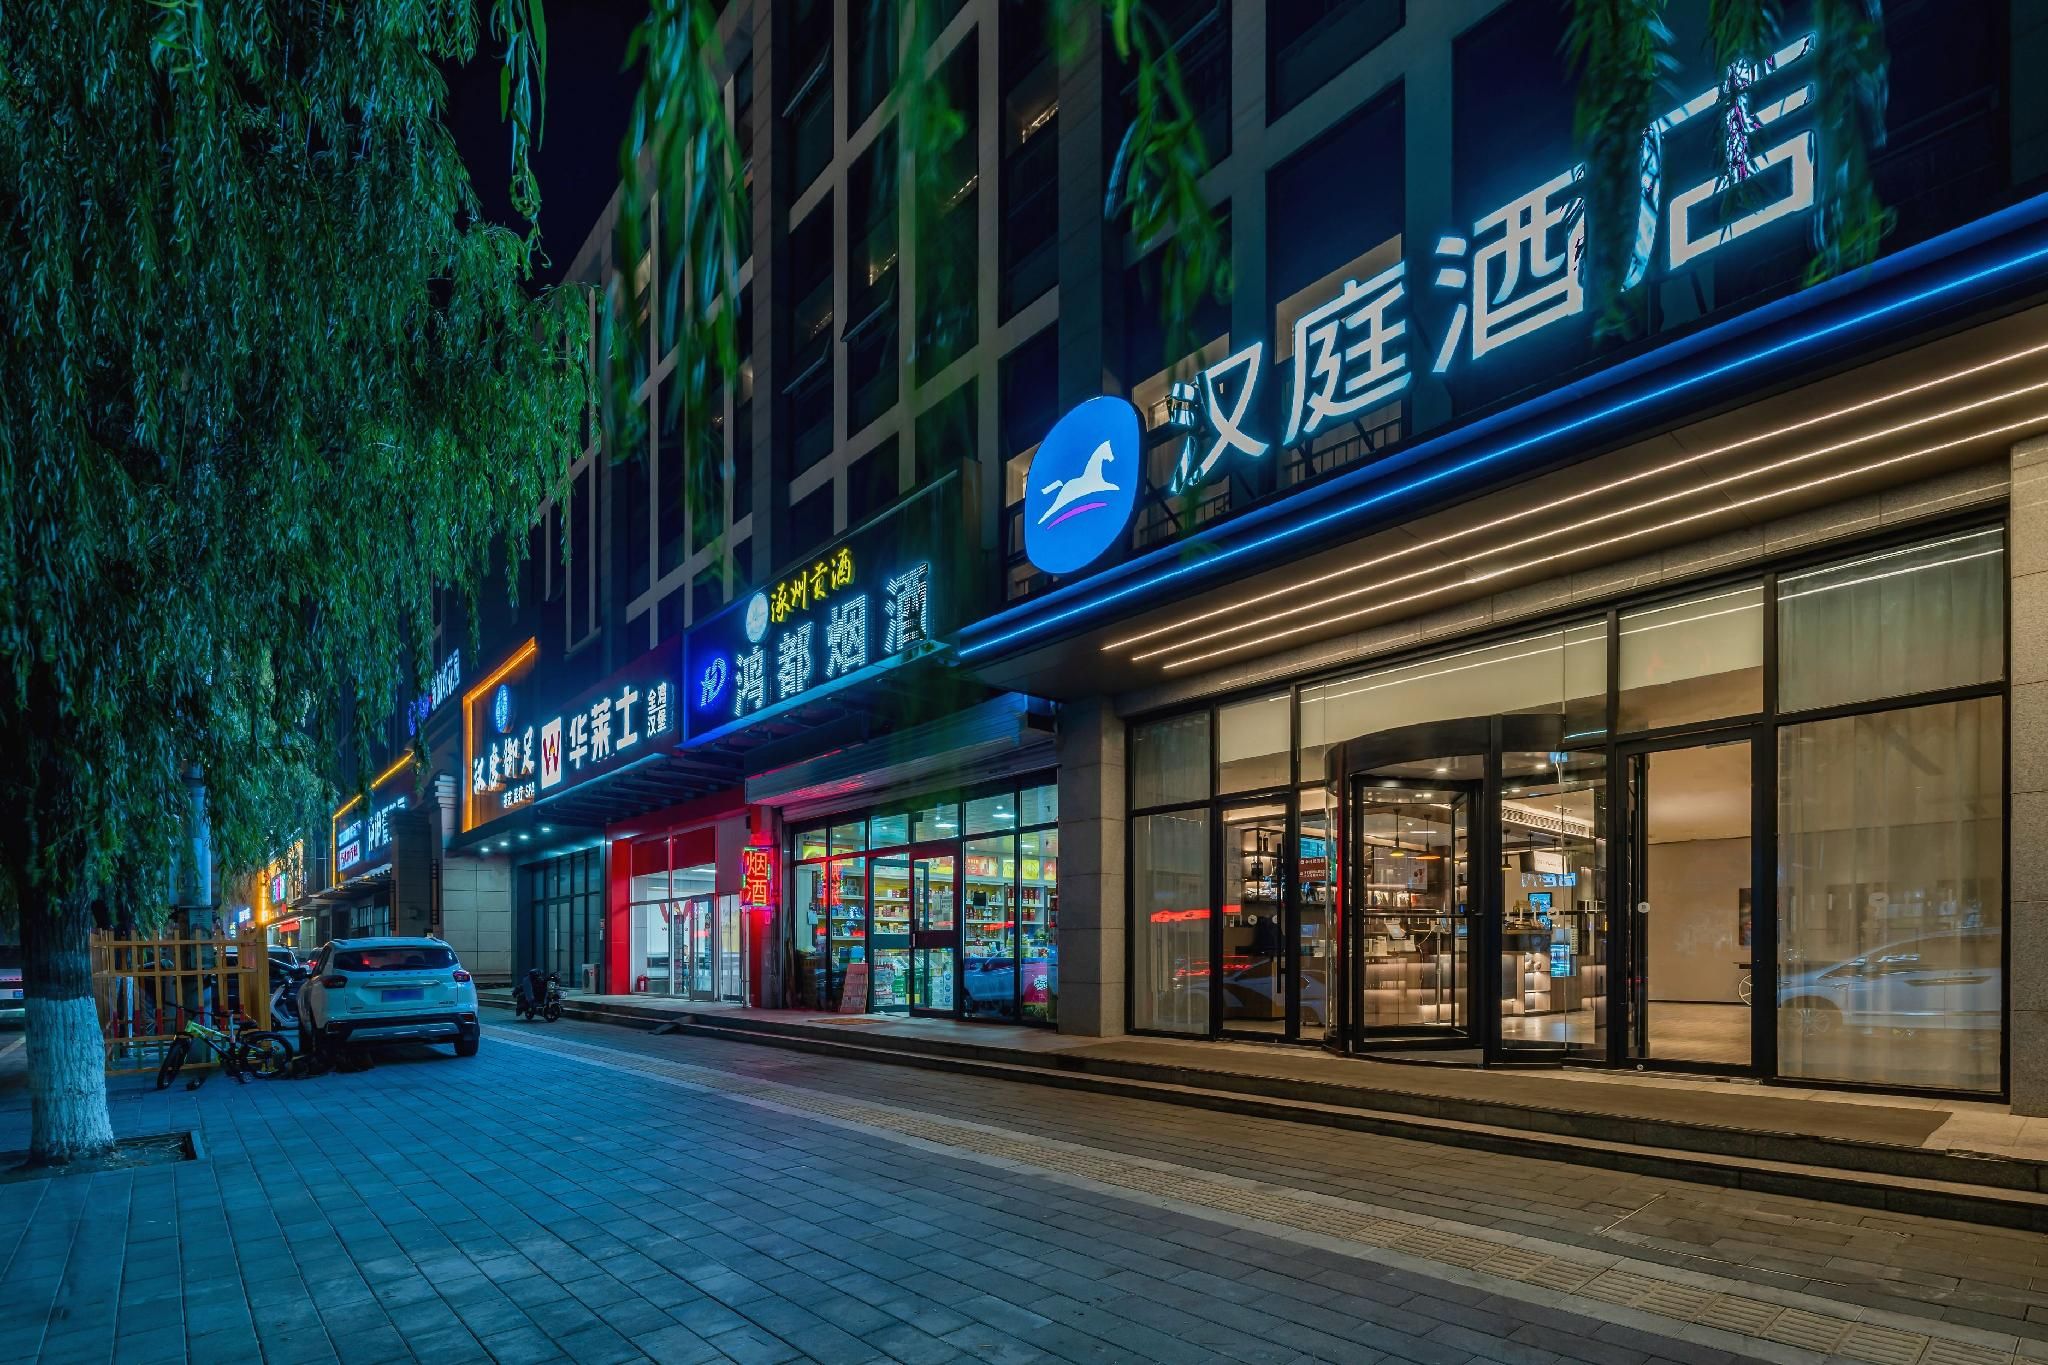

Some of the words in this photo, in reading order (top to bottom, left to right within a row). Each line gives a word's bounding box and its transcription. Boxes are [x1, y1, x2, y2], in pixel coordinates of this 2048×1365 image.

[1169, 32, 1817, 494] 汉庭酒店
[734, 562, 929, 717] 鸿都烟酒
[569, 685, 638, 769] 华莱士
[746, 852, 768, 905] 烟酒
